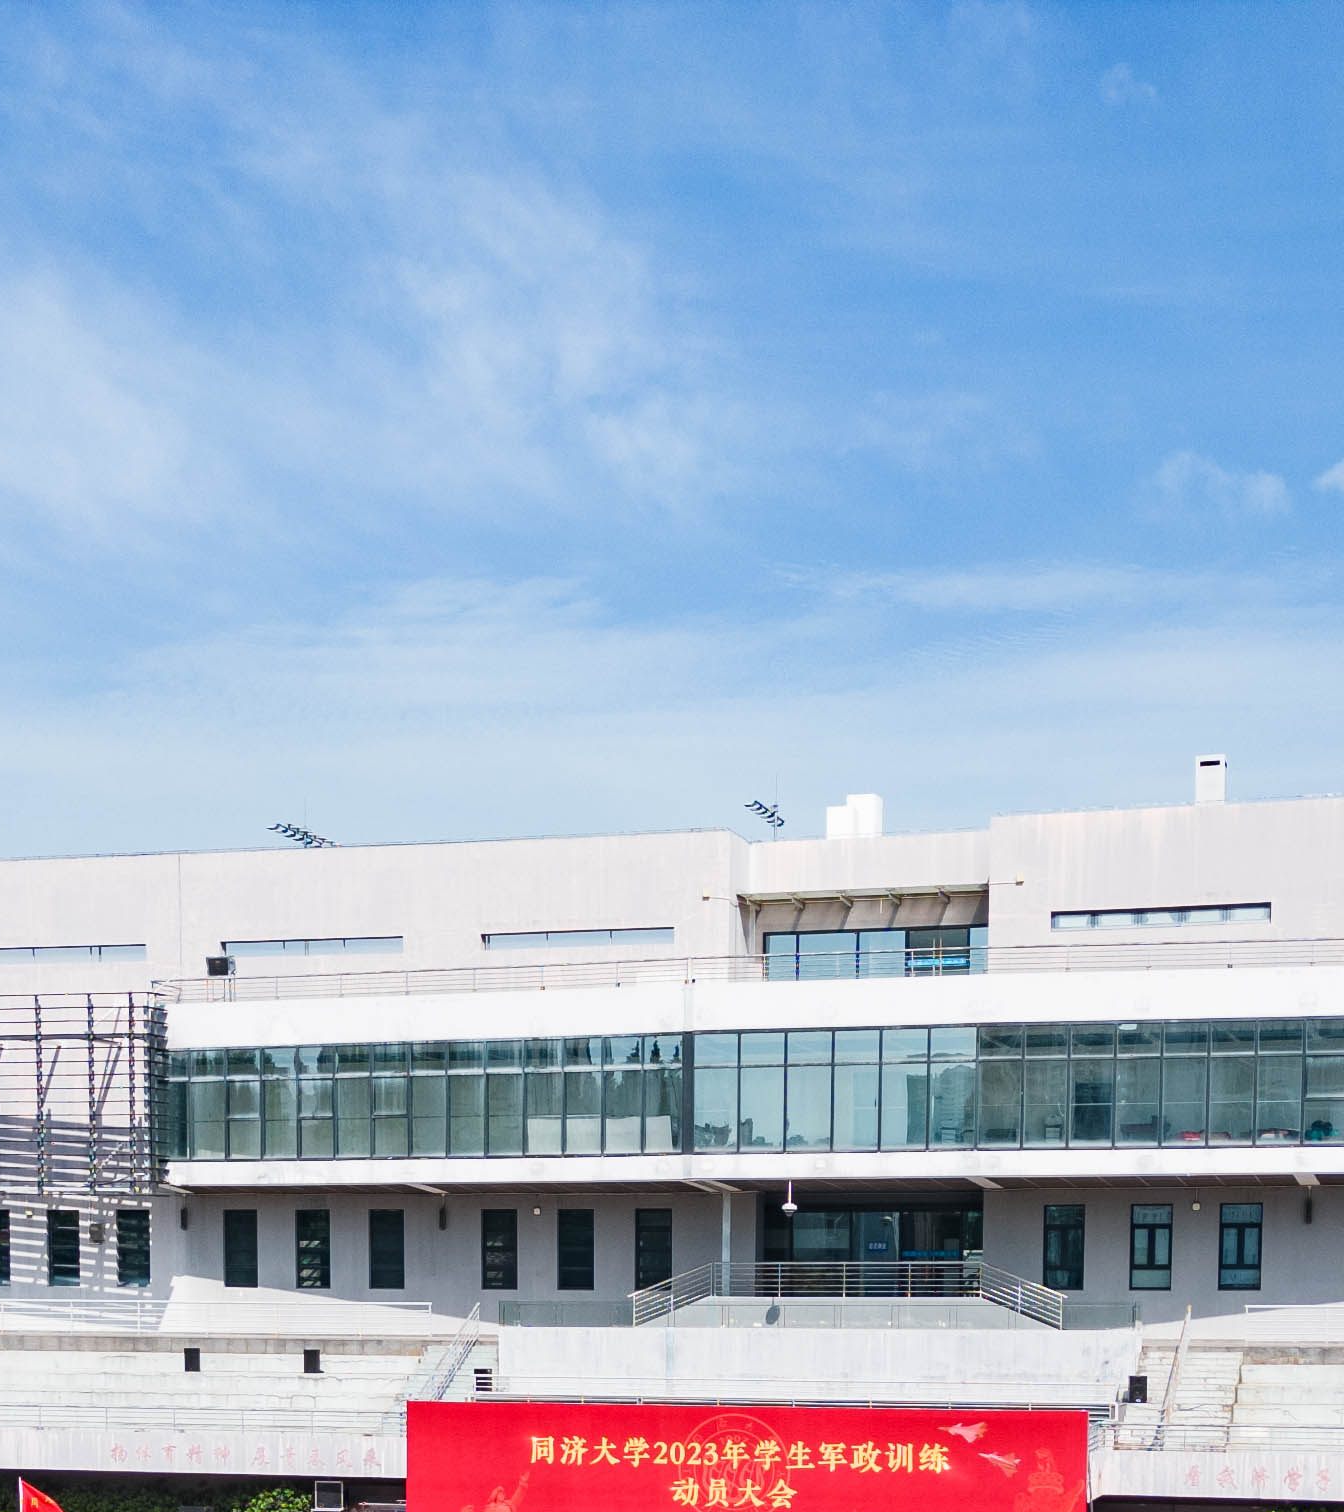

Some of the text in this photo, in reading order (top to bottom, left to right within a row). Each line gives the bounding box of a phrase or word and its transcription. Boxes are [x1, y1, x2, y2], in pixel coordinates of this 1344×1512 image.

[530, 1435, 951, 1473] 同济大学2023年学生军政训练
[670, 1477, 798, 1507] 动员大会
